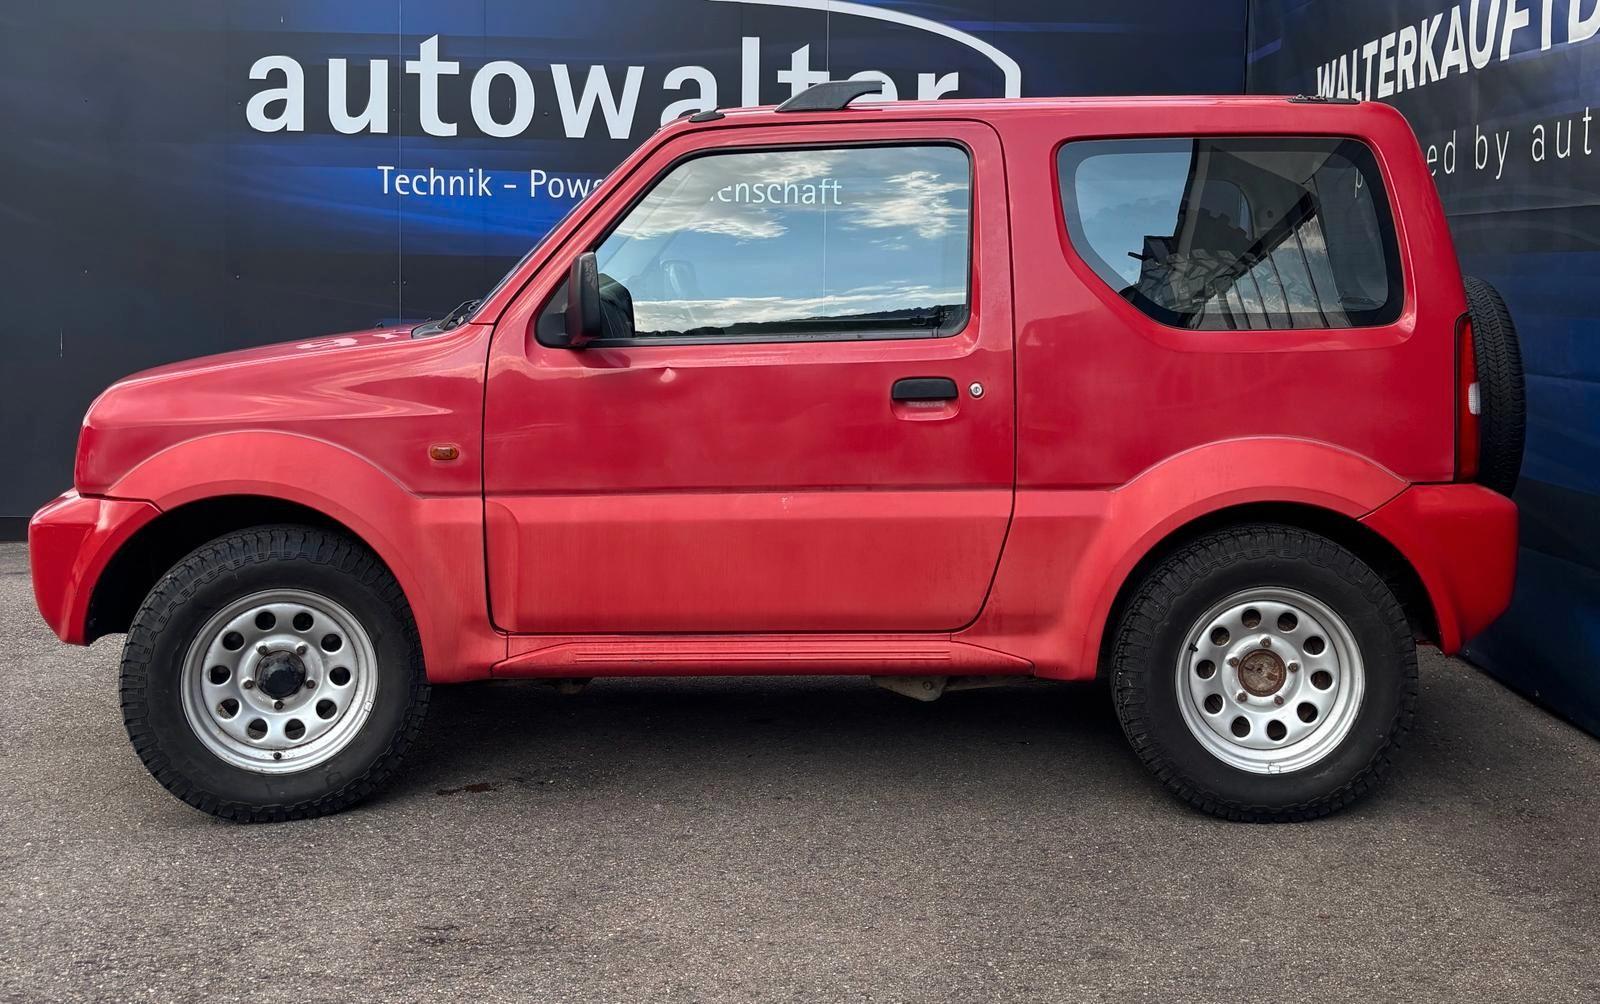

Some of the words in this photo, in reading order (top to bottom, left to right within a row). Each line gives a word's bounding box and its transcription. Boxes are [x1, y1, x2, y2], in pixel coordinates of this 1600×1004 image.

[1475, 124, 1510, 180] by
[377, 165, 492, 197] Technik
[710, 177, 842, 205] enschaft
